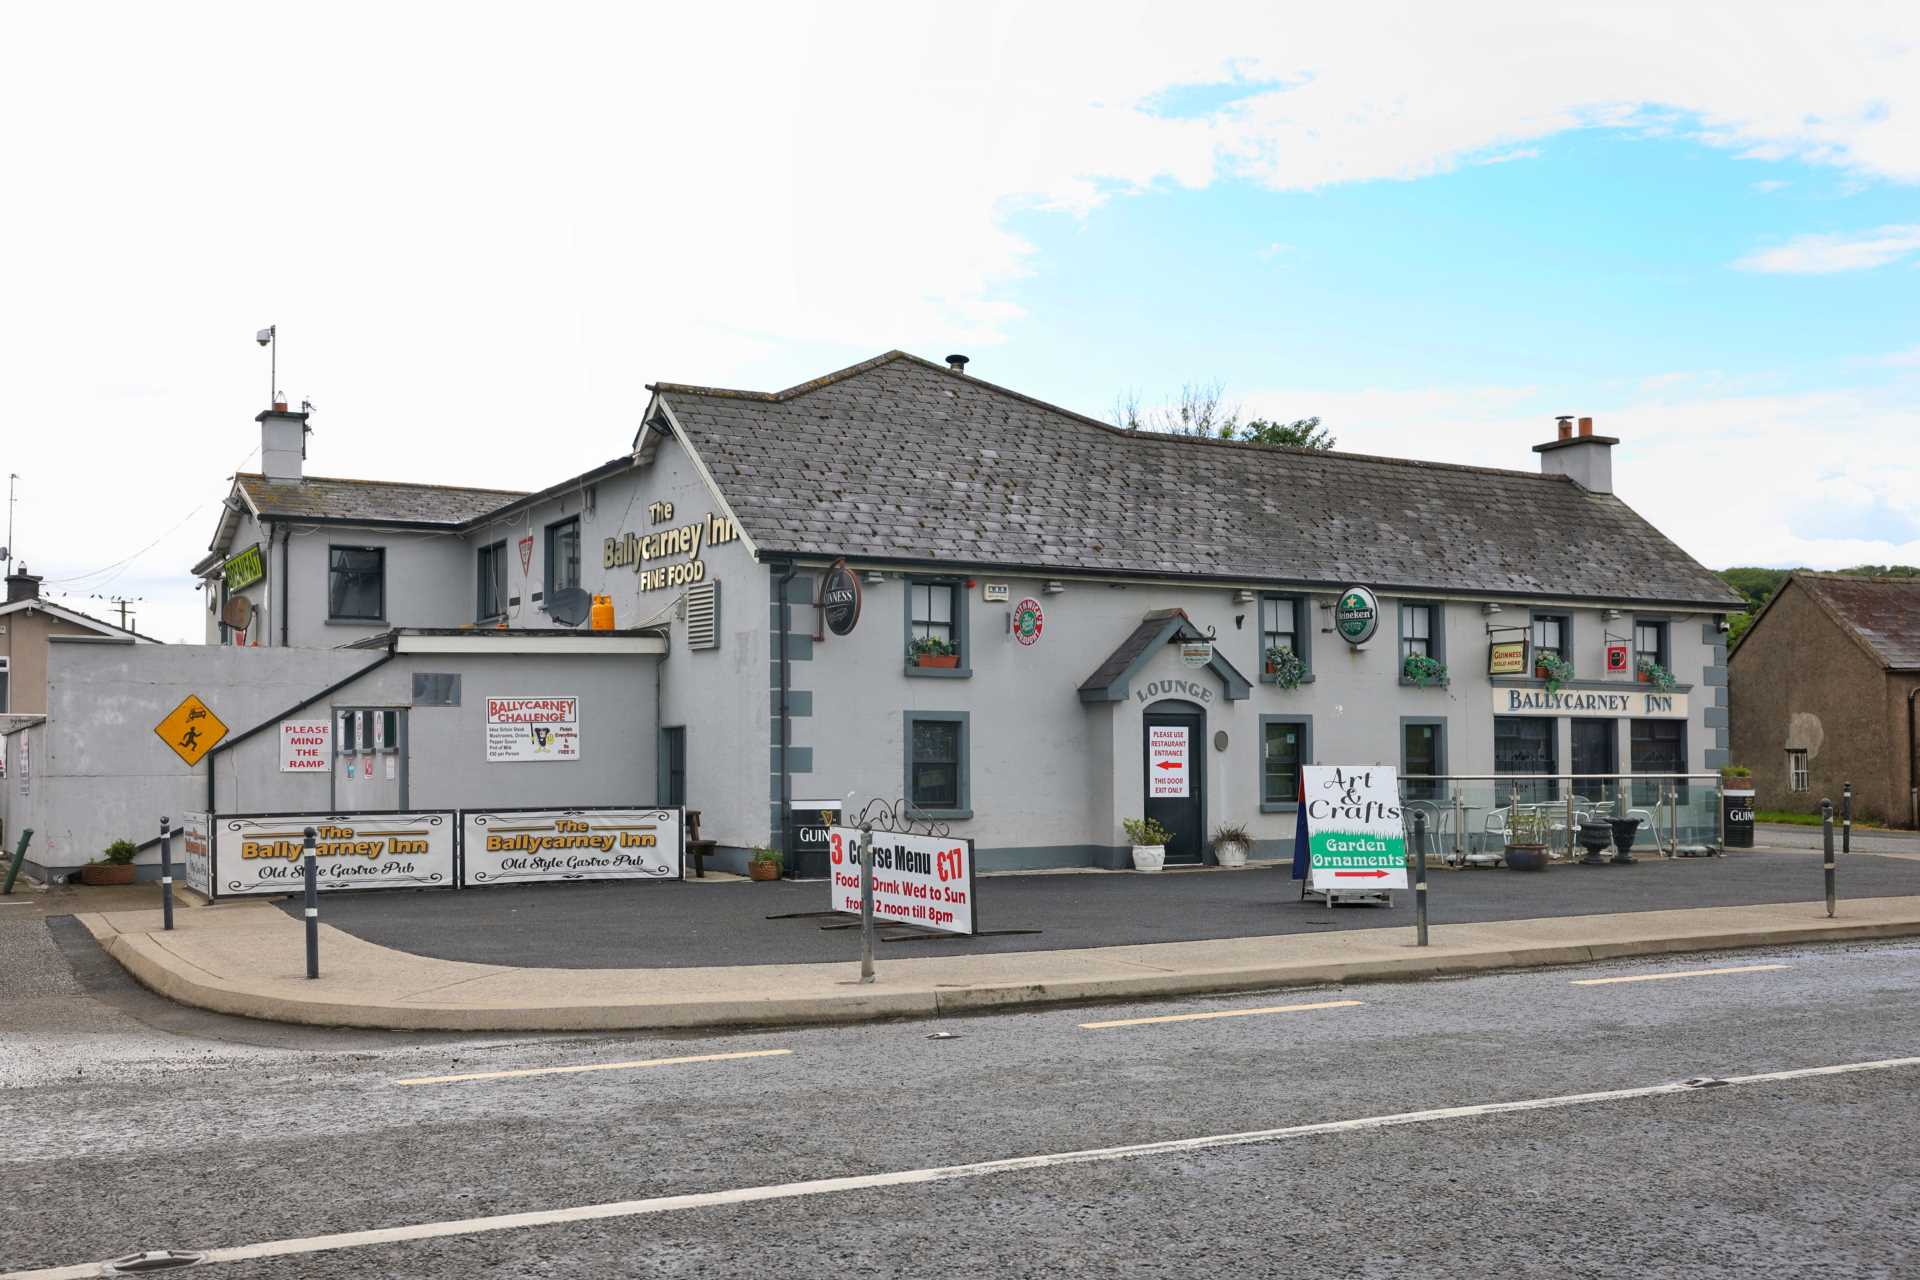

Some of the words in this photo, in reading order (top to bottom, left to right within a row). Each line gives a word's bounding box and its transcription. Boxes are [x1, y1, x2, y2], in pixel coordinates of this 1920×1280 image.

[648, 502, 673, 525] The
[603, 523, 703, 572] Ballycarney
[705, 512, 740, 547] Inn
[640, 567, 666, 592] FINE
[668, 560, 704, 586] FOOD
[1136, 680, 1213, 703] LOUNGE
[1508, 689, 1630, 710] BALLYCARNEY
[490, 700, 575, 716] BALLYCARNEY
[498, 713, 565, 722] CHALLENGE
[285, 726, 328, 734] PLEASE
[290, 737, 324, 745] MIND
[289, 760, 325, 768] RAMP
[1323, 768, 1372, 792] Art
[1340, 788, 1362, 805] &
[1308, 800, 1400, 823] Crafts
[317, 826, 353, 840] The
[555, 820, 589, 832] The
[241, 839, 383, 862] Ballyarney
[388, 838, 429, 855] Inn
[486, 834, 616, 854] Ballycarney
[620, 832, 656, 848] Inn
[1326, 839, 1386, 852] Garden
[501, 857, 527, 870] Old
[529, 856, 563, 871] Style
[566, 855, 610, 869] Gastro
[613, 854, 644, 867] Pub
[830, 833, 843, 865] 3
[849, 839, 893, 870] Corse
[894, 846, 931, 875] Menu
[936, 848, 962, 882] €17
[1312, 853, 1405, 867] Ornaments
[258, 865, 287, 880] Old
[330, 863, 377, 879] Gastro
[381, 862, 415, 875] Pub
[835, 872, 859, 889] Food
[872, 876, 899, 896] Drink
[902, 881, 926, 899] Wed
[930, 885, 942, 901] to
[944, 888, 966, 905] Sun
[884, 903, 910, 916] noon
[912, 904, 926, 918] till
[929, 906, 953, 926] 8pm
